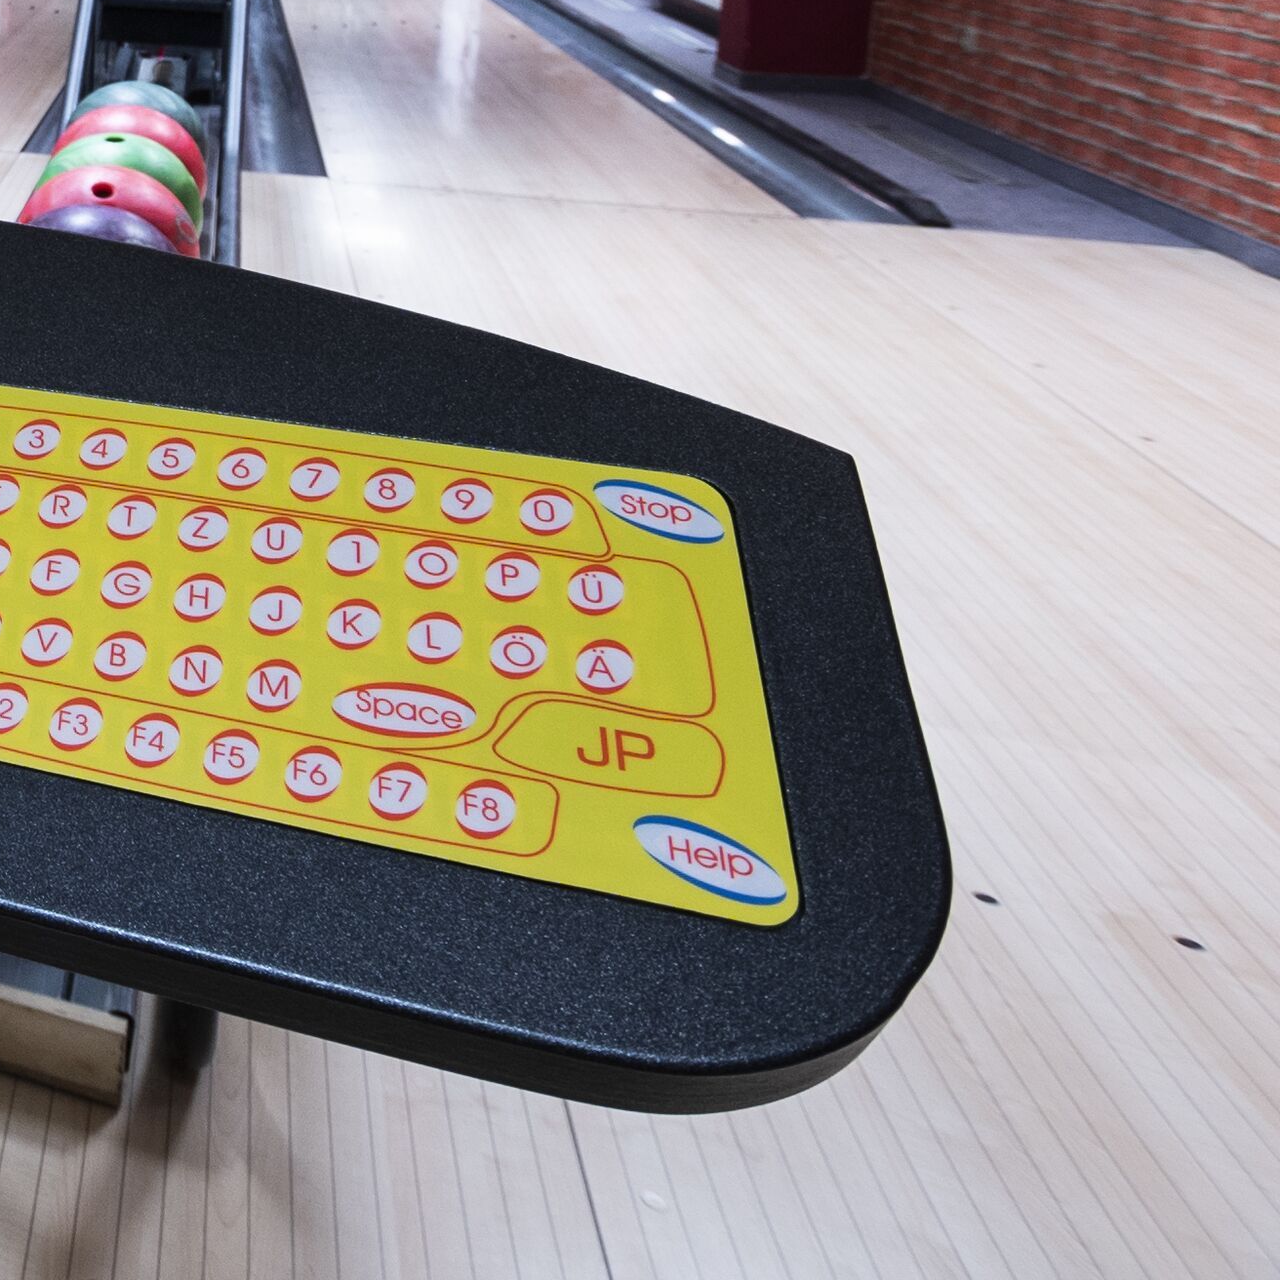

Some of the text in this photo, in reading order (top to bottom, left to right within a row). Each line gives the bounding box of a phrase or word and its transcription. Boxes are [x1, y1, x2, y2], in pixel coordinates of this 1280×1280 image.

[28, 428, 45, 450] 3
[90, 438, 109, 459] 4
[161, 447, 180, 469] 5
[231, 458, 251, 480] 6
[306, 467, 323, 489] 7
[377, 477, 397, 501] 8
[454, 488, 476, 511] 9
[532, 499, 556, 523] 0
[620, 493, 693, 525] Stop
[51, 493, 71, 518] R
[122, 504, 138, 528] T
[191, 515, 210, 540] Z
[265, 526, 286, 552] U
[417, 551, 449, 577] O
[500, 562, 520, 587] P
[580, 573, 604, 604] Ü
[45, 559, 63, 582] F
[113, 572, 142, 597] G
[188, 583, 210, 610] H
[266, 598, 284, 623] J
[342, 609, 364, 637] K
[425, 623, 442, 651] L
[502, 634, 536, 668] Ö
[586, 649, 617, 684] Ä
[36, 627, 59, 654] V
[109, 641, 127, 668] B
[183, 655, 208, 685] N
[258, 670, 289, 701] M
[355, 689, 464, 732] Space
[57, 709, 89, 737] F3
[132, 725, 165, 753] F4
[211, 741, 246, 770] F5
[292, 758, 328, 787] F6
[377, 775, 413, 803] F7
[462, 792, 501, 823] F8
[576, 726, 656, 772] JP
[666, 835, 754, 879] Help
